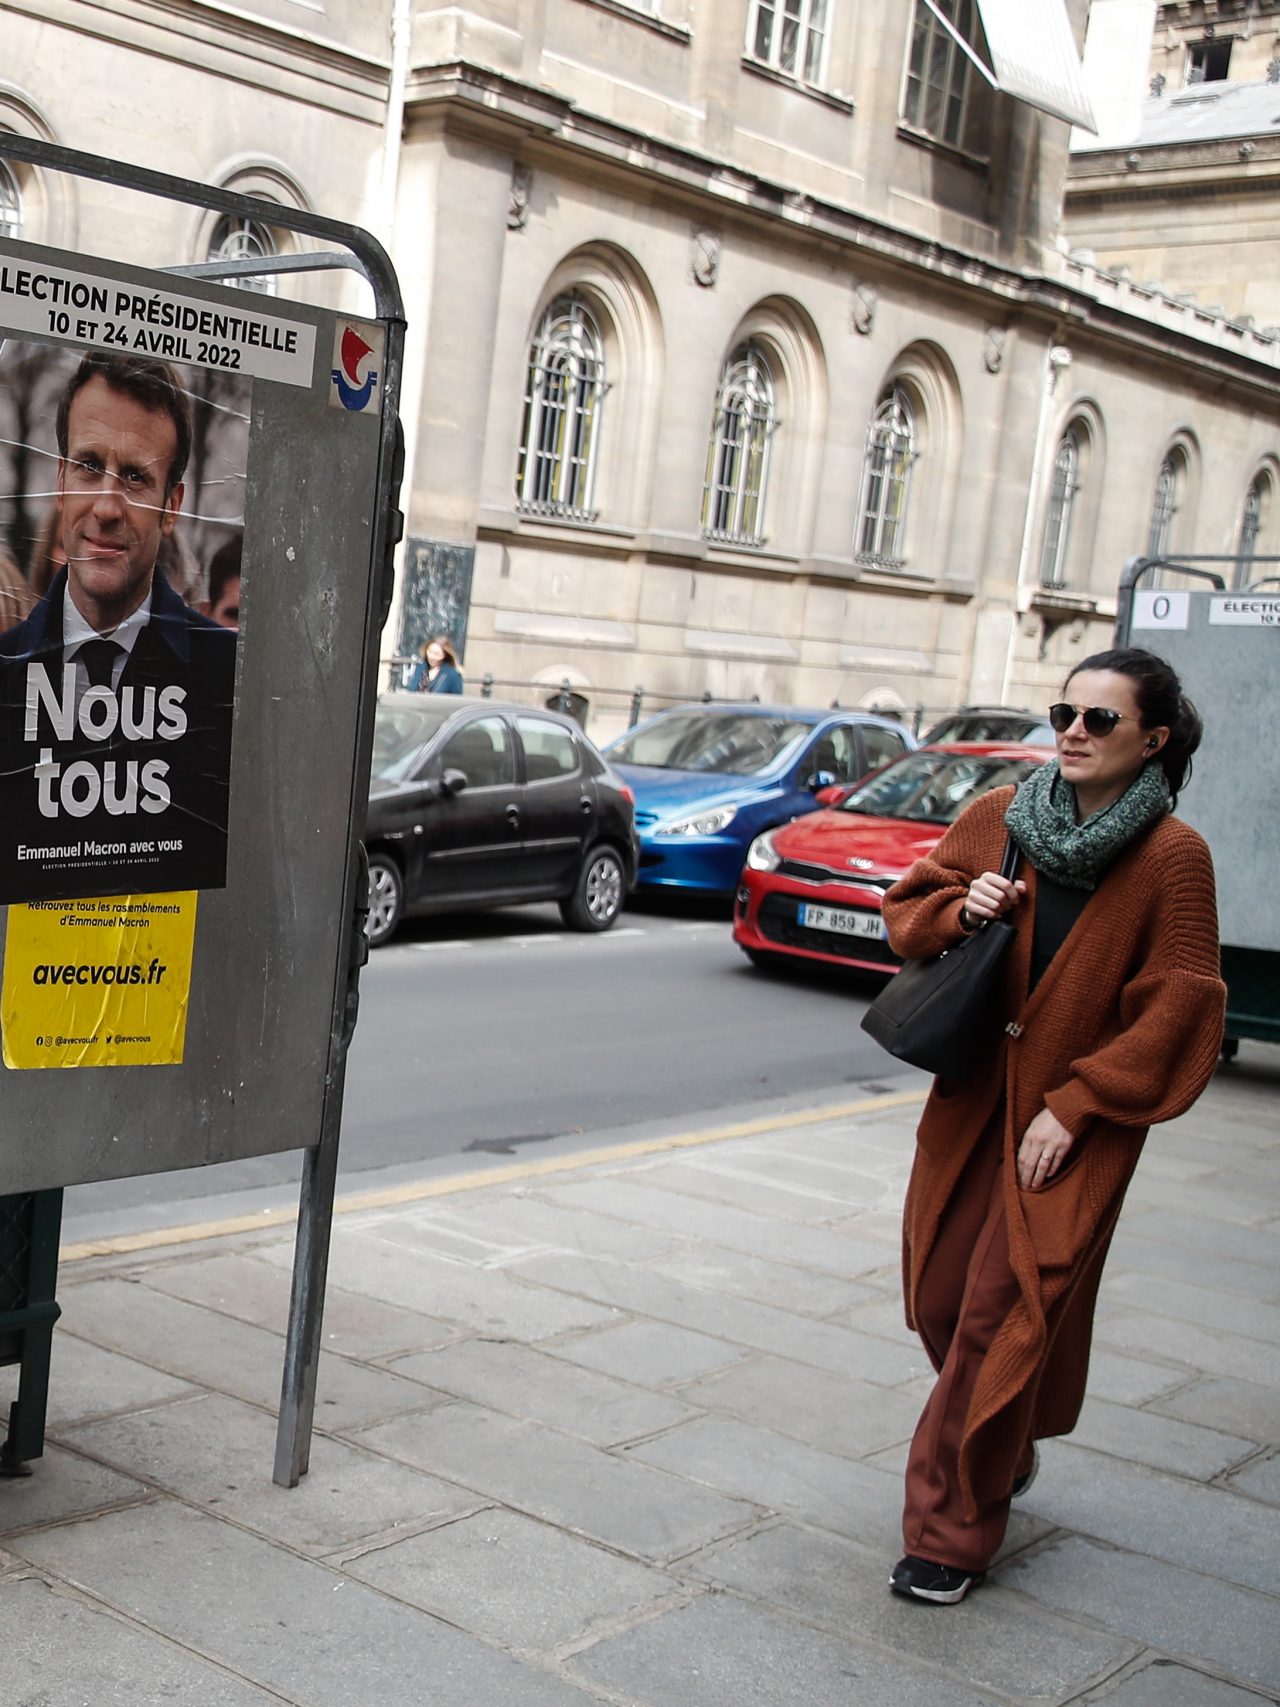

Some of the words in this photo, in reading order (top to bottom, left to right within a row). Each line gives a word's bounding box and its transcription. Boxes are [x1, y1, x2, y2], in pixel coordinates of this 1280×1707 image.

[48, 310, 71, 335] 10
[76, 322, 99, 341] ET
[103, 321, 128, 346] 24
[132, 327, 192, 360] AVRIL
[196, 341, 241, 370] 2022
[115, 290, 299, 354] PRÉSIDENTIELLE
[24, 662, 189, 742] Nous
[34, 748, 171, 818] tous
[17, 842, 81, 860] Emmanuel
[84, 840, 127, 857] Macron
[130, 841, 155, 855] avec
[158, 839, 183, 852] vous
[28, 901, 75, 911] Retrouvez
[77, 901, 96, 911] tous
[98, 901, 110, 912] les
[112, 902, 181, 914] rasemblements
[60, 915, 117, 927] d'Emmanuel
[119, 916, 150, 928] Macron
[33, 958, 167, 985] avecvous.fr
